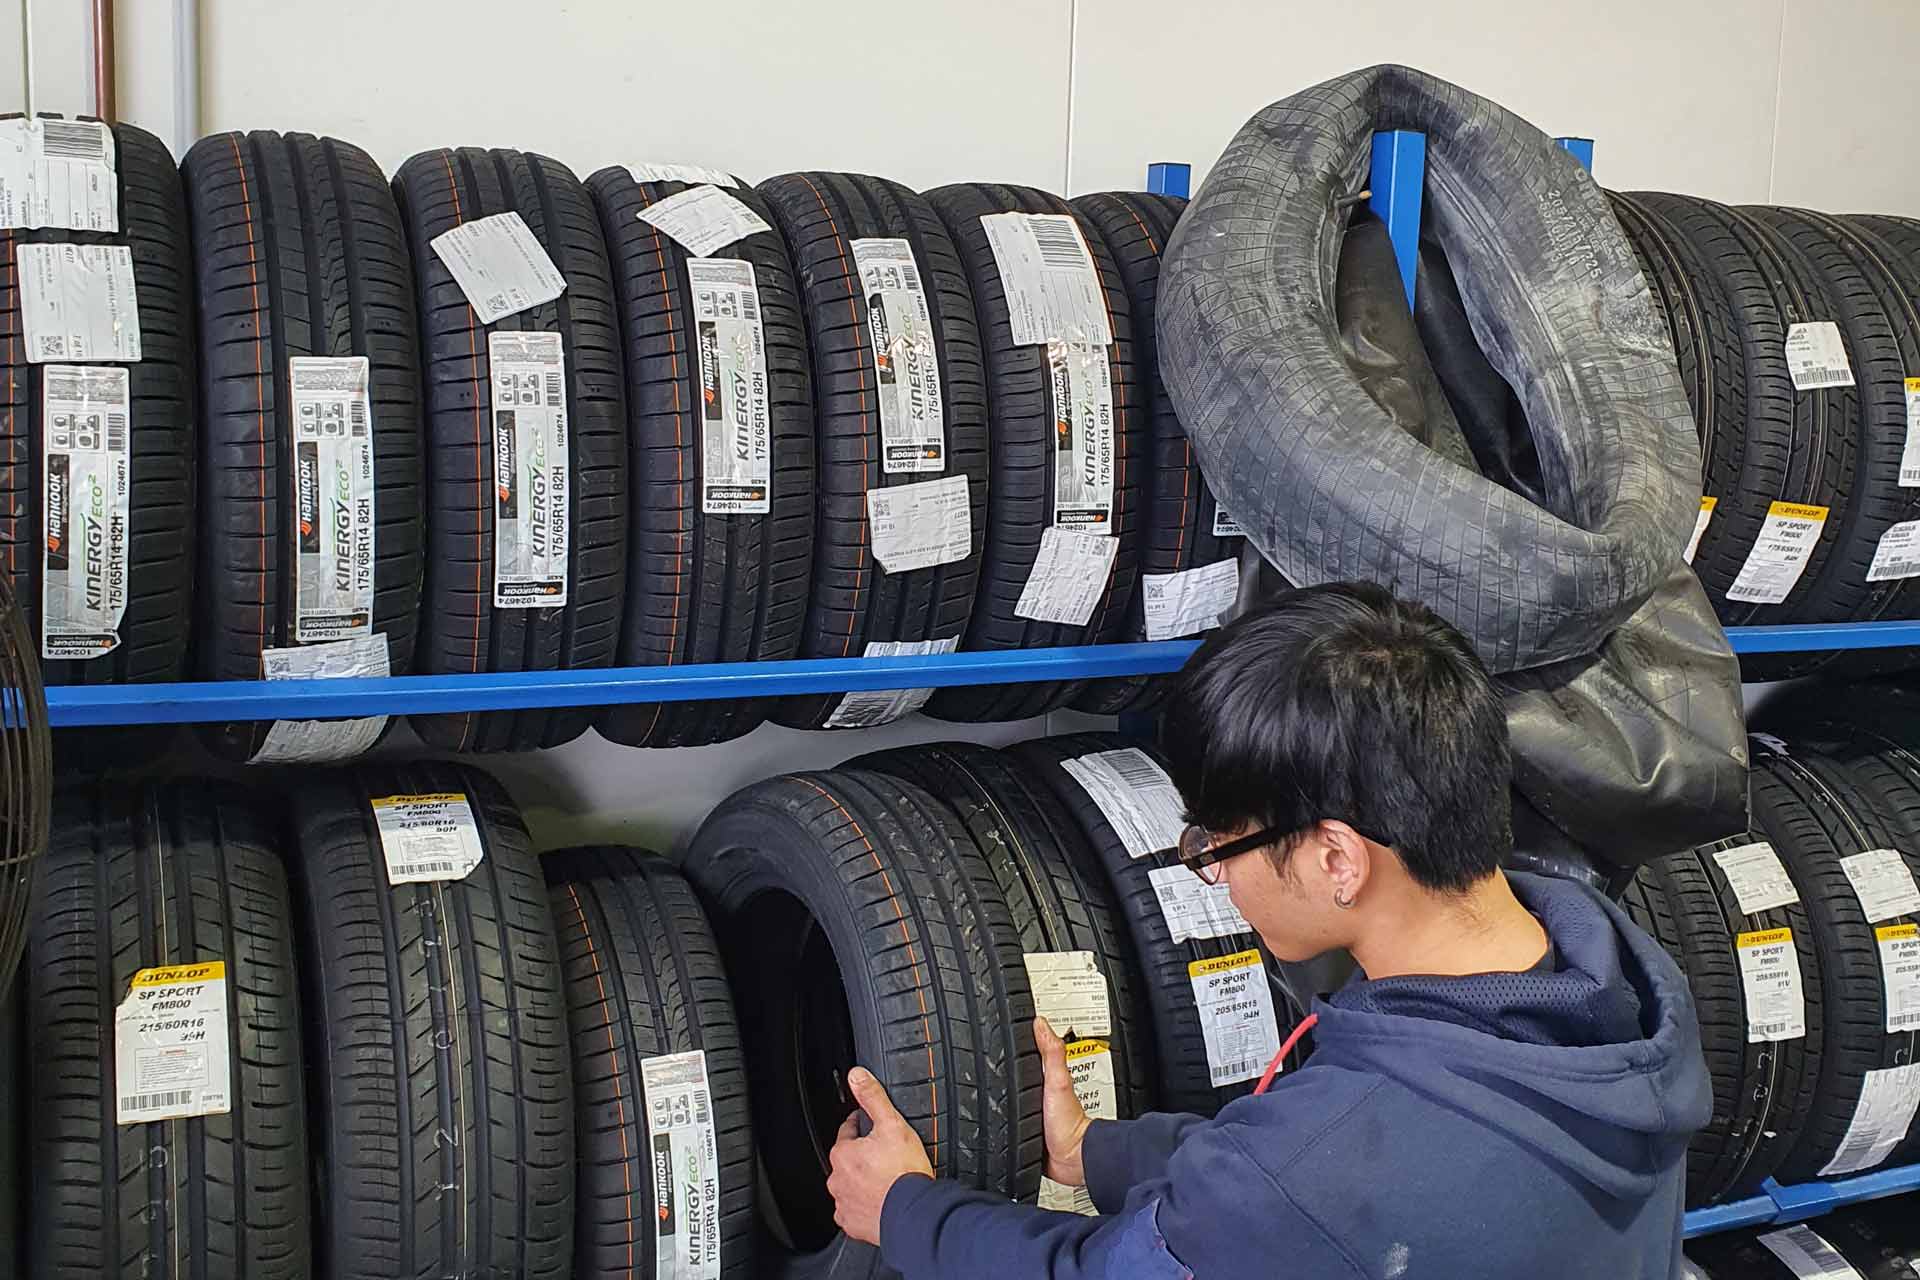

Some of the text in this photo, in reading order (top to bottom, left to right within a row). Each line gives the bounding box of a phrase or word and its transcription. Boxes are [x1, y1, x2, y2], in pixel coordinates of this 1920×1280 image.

[752, 372, 766, 460] 175/65R14 82H
[1100, 403, 1110, 486] 175/65R14 82H
[361, 444, 369, 479] 1024674
[552, 466, 564, 557] 175/65R14 82H
[111, 516, 123, 541] 82H
[358, 499, 369, 590] 175/65R14 82H
[1762, 946, 1784, 956] SPORT
[1208, 955, 1251, 971] DUNLOP
[141, 968, 210, 982] DUNLOP
[1209, 972, 1250, 988] SP SPORT
[138, 985, 205, 1000] SP SPORT
[1219, 985, 1246, 997] FM800
[152, 1000, 191, 1011] FM800
[139, 1018, 205, 1033] 215/60R16
[1068, 1044, 1098, 1056] NLOP
[1073, 1074, 1089, 1084] 800
[705, 1129, 714, 1161] 1024674
[704, 1178, 716, 1263] 175/65R14 82H
